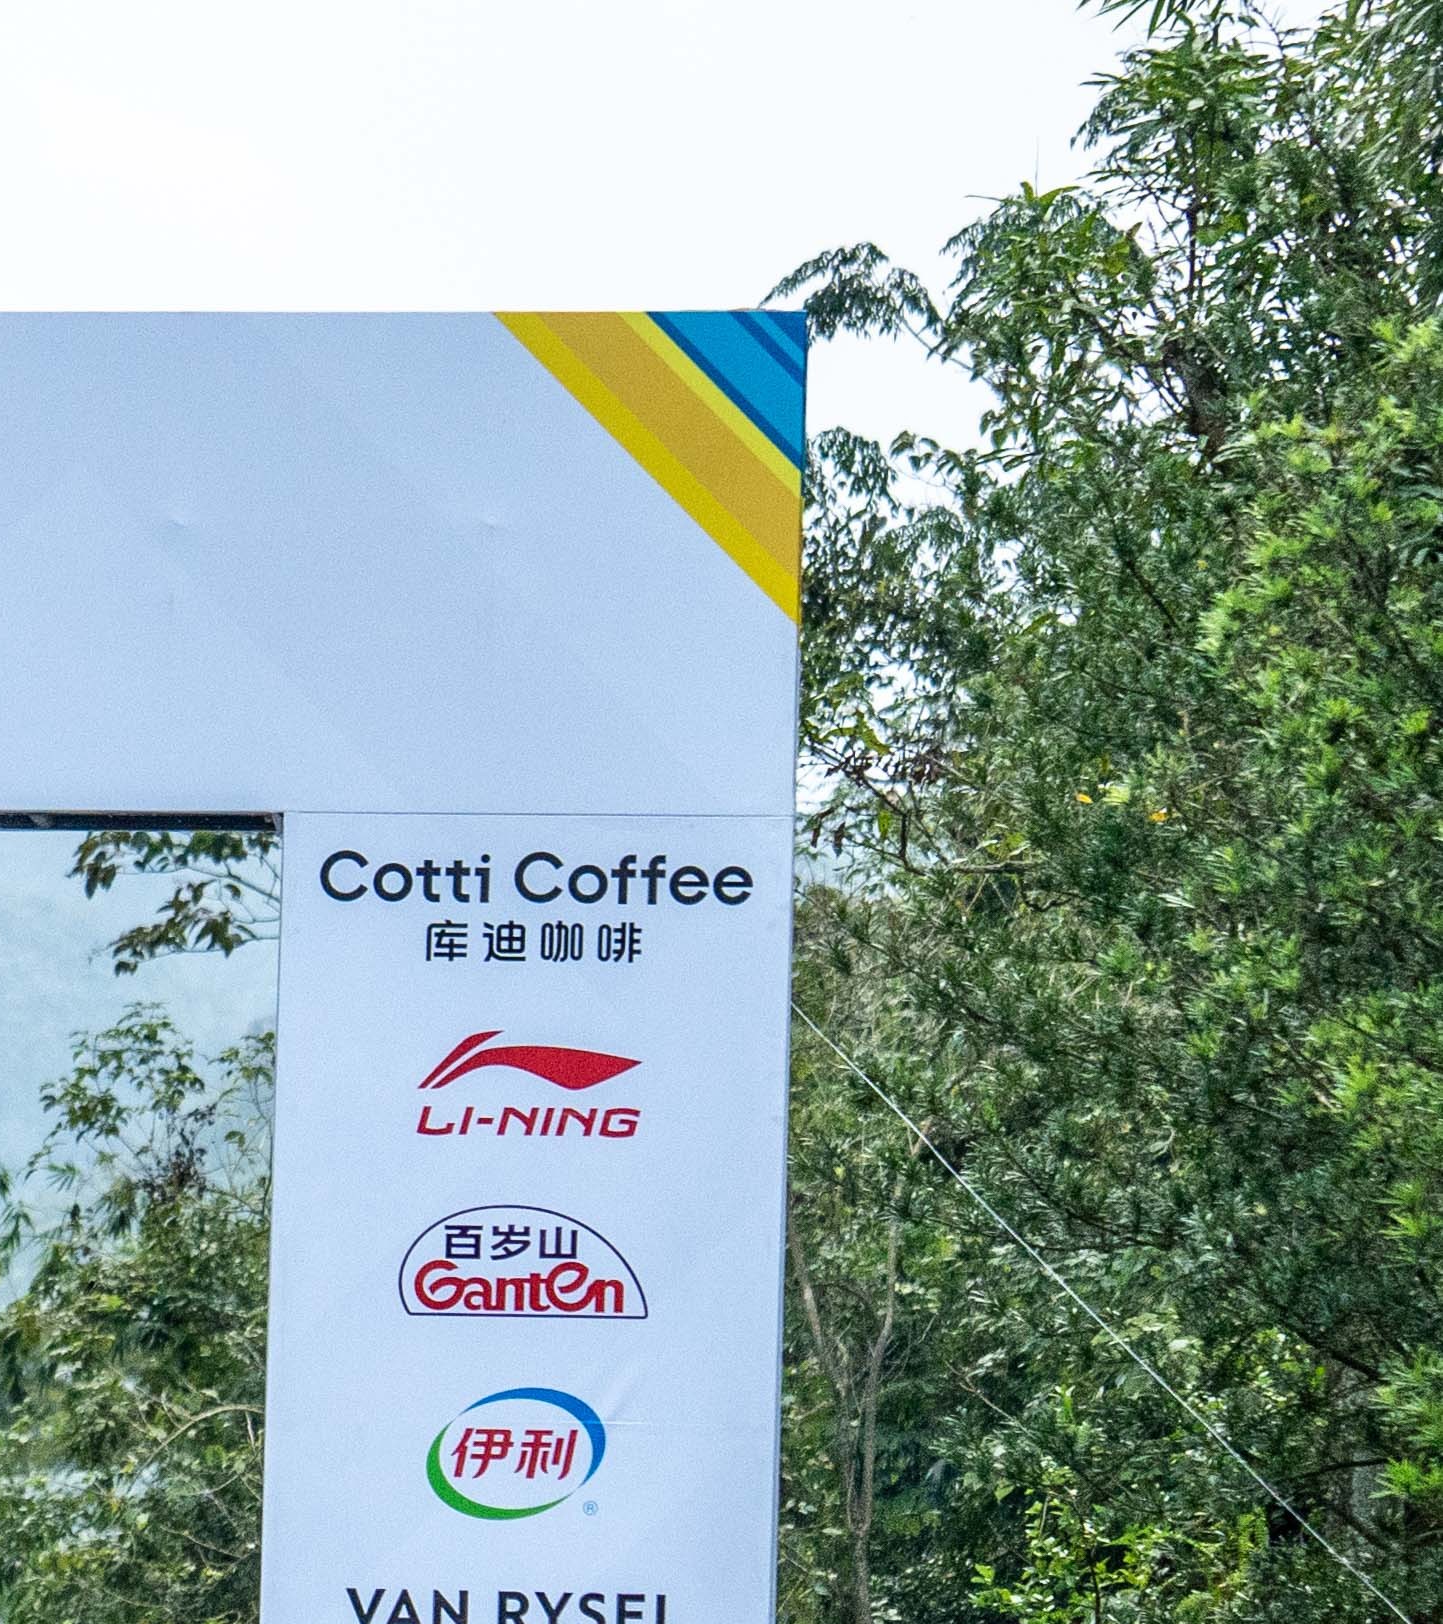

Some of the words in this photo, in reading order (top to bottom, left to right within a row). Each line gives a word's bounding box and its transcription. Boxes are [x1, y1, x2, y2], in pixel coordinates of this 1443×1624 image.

[319, 849, 491, 903] Cotti
[514, 851, 754, 906] Coffee
[425, 919, 642, 963] 库迪咖啡
[416, 1105, 641, 1139] LI-NING
[444, 1226, 579, 1261] 百岁山
[414, 1260, 625, 1315] Ganten
[451, 1427, 578, 1481] 伊利
